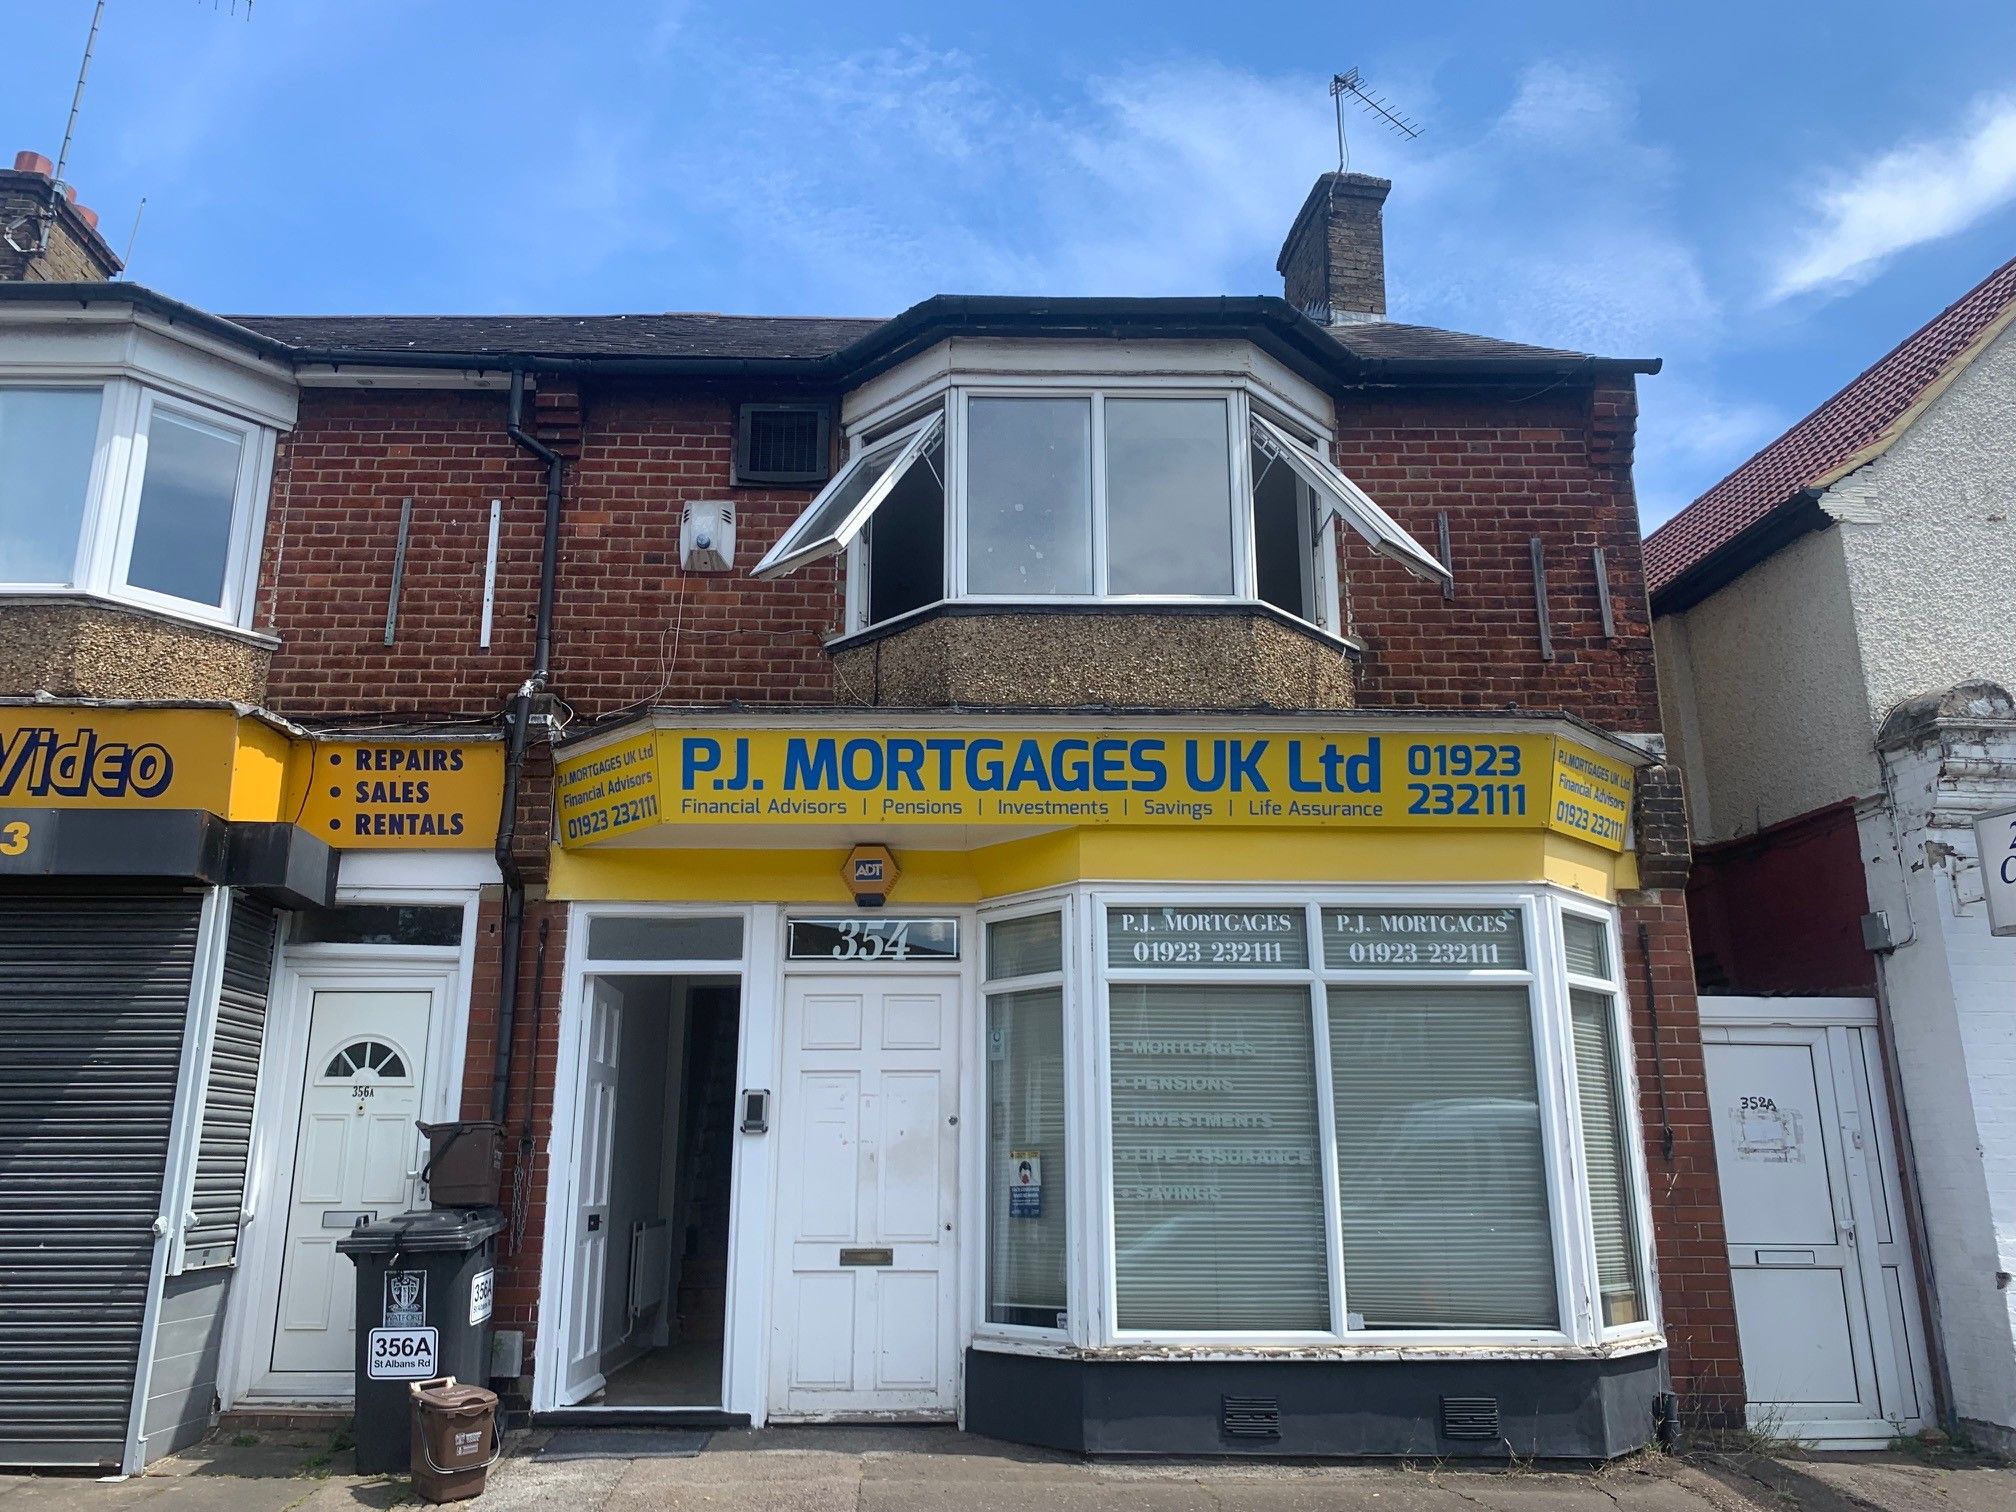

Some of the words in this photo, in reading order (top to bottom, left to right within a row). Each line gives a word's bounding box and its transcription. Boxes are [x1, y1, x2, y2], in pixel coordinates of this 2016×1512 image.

[355, 748, 464, 771] REPAIRS
[623, 752, 637, 766] UK
[639, 743, 653, 760] Ltd
[682, 738, 764, 790] P.J.
[783, 738, 1167, 792] MORTGAGES
[1185, 740, 1270, 792] UK
[1288, 737, 1381, 793] Ltd
[1408, 744, 1521, 776] 01923
[355, 780, 430, 803] SALES
[563, 782, 605, 809] Financial
[608, 771, 653, 795] Advisors
[1407, 783, 1526, 815] 232111
[1559, 772, 1592, 799] Financial
[1594, 786, 1626, 811] Advisors
[568, 809, 608, 839] 01923
[611, 794, 658, 827] 232111
[682, 798, 761, 814] Financial
[767, 798, 847, 814] Advisors
[883, 799, 962, 815] Pensions
[998, 800, 1109, 815] Investments
[1144, 800, 1213, 820] Savings
[1250, 800, 1282, 816] Life
[1288, 800, 1383, 816] Assurance
[355, 812, 464, 835] RENTALS
[1556, 800, 1589, 830] 01923
[1590, 812, 1623, 843] 232111
[856, 863, 882, 877] ADT
[1122, 914, 1155, 933] P.J.
[1165, 914, 1292, 932] MORTGAGES
[1336, 914, 1371, 934] P.J.
[1380, 915, 1508, 933] MORTGAGES
[832, 919, 911, 961] 354
[1133, 941, 1201, 962] 01923
[1211, 941, 1282, 962] 232111
[1349, 942, 1418, 963] 01923
[1427, 942, 1499, 963] 232111
[352, 1086, 374, 1098] 356A
[1133, 1076, 1234, 1091] PENSIONS
[1134, 1112, 1274, 1127] INVESTMENTS
[474, 1278, 492, 1302] 356A
[375, 1337, 432, 1357] 356A
[374, 1360, 383, 1368] St
[385, 1360, 415, 1368] Albans
[418, 1359, 431, 1367] Rd
